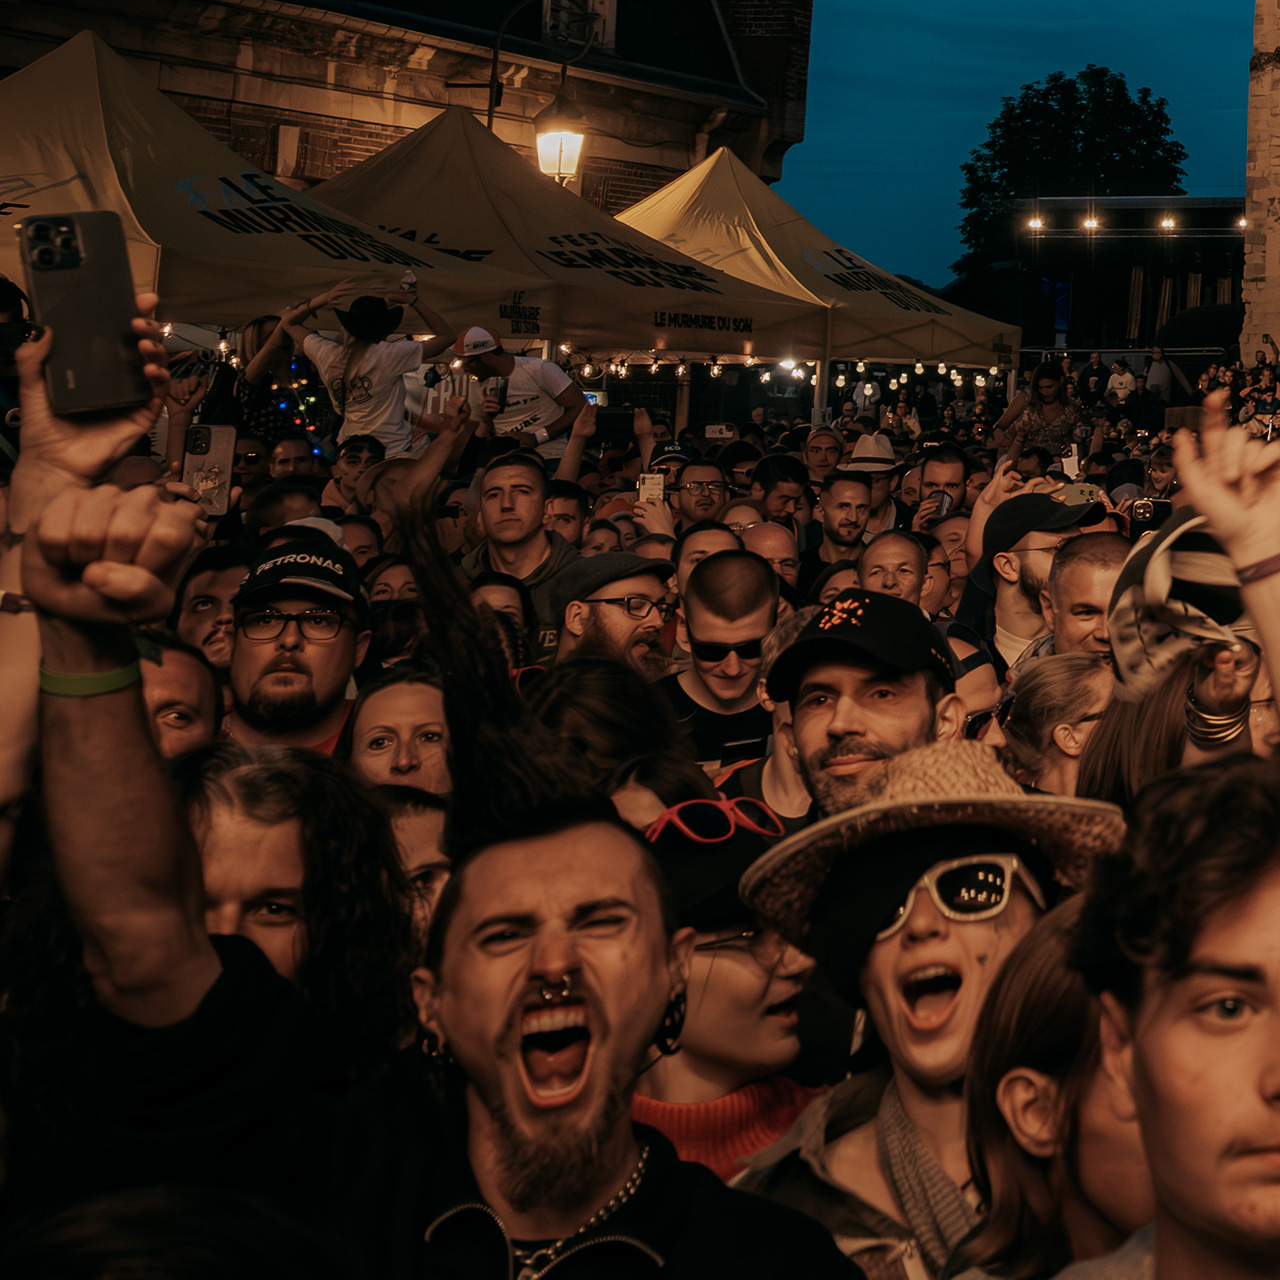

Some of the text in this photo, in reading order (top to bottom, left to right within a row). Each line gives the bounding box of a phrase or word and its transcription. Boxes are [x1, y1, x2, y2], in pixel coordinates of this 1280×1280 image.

[218, 173, 291, 205] LE
[297, 232, 371, 262] DU
[823, 248, 866, 270] LE
[513, 290, 525, 305] LE
[654, 311, 753, 333] LE MURMURE DU SON
[256, 553, 344, 576] PETRONAS
